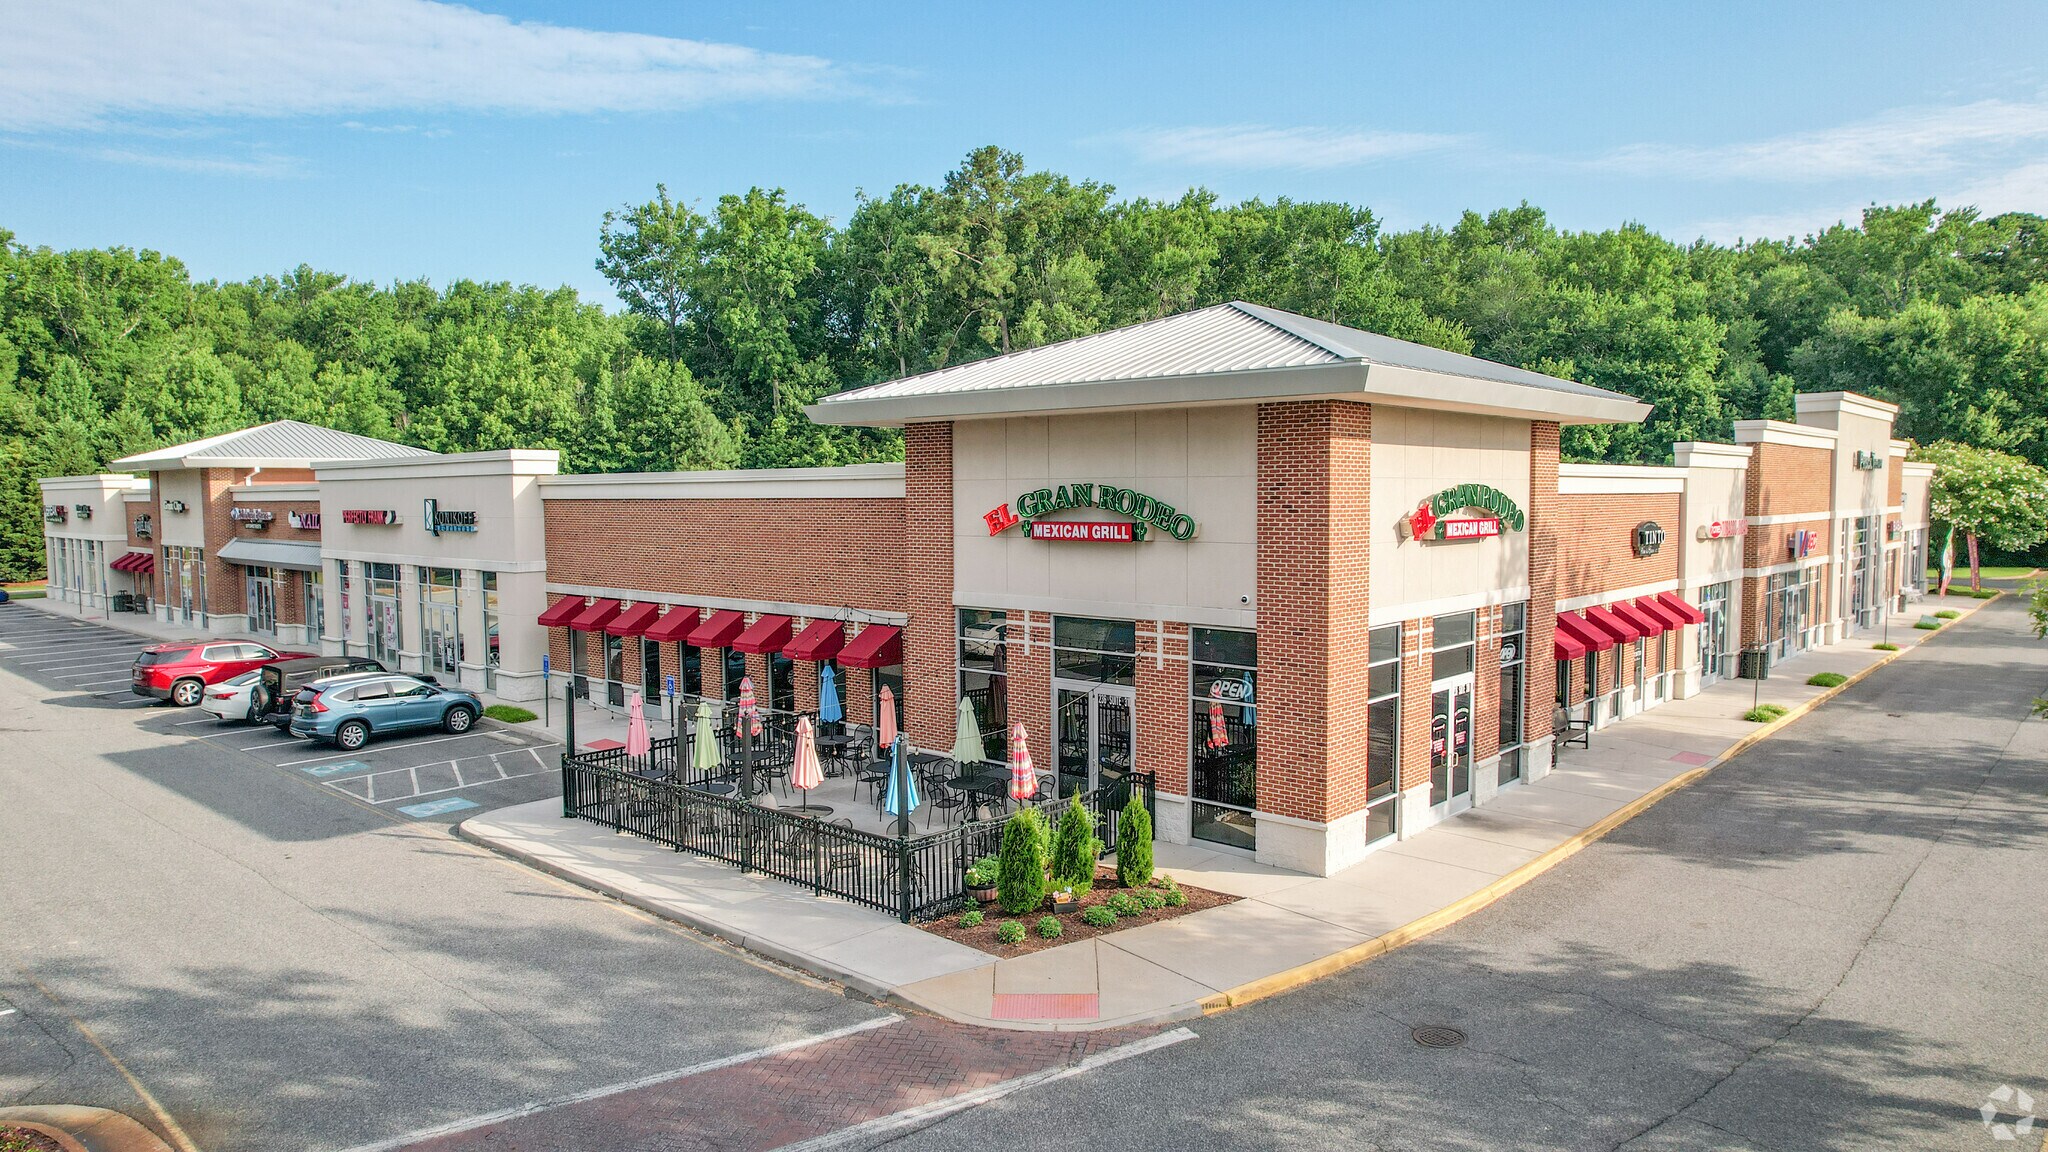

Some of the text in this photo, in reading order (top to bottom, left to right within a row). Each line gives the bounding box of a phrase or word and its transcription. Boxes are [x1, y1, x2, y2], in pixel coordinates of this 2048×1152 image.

[435, 511, 475, 524] KONIKOFF
[983, 483, 1196, 541] EL GRAN RODEO
[1409, 484, 1524, 541] EL GRAN RODEO
[1033, 524, 1129, 540] MEXICAN GRILL
[1446, 520, 1498, 537] MEXICAN GRILL
[1645, 530, 1666, 545] TINTO
[1211, 680, 1248, 699] OPEN
